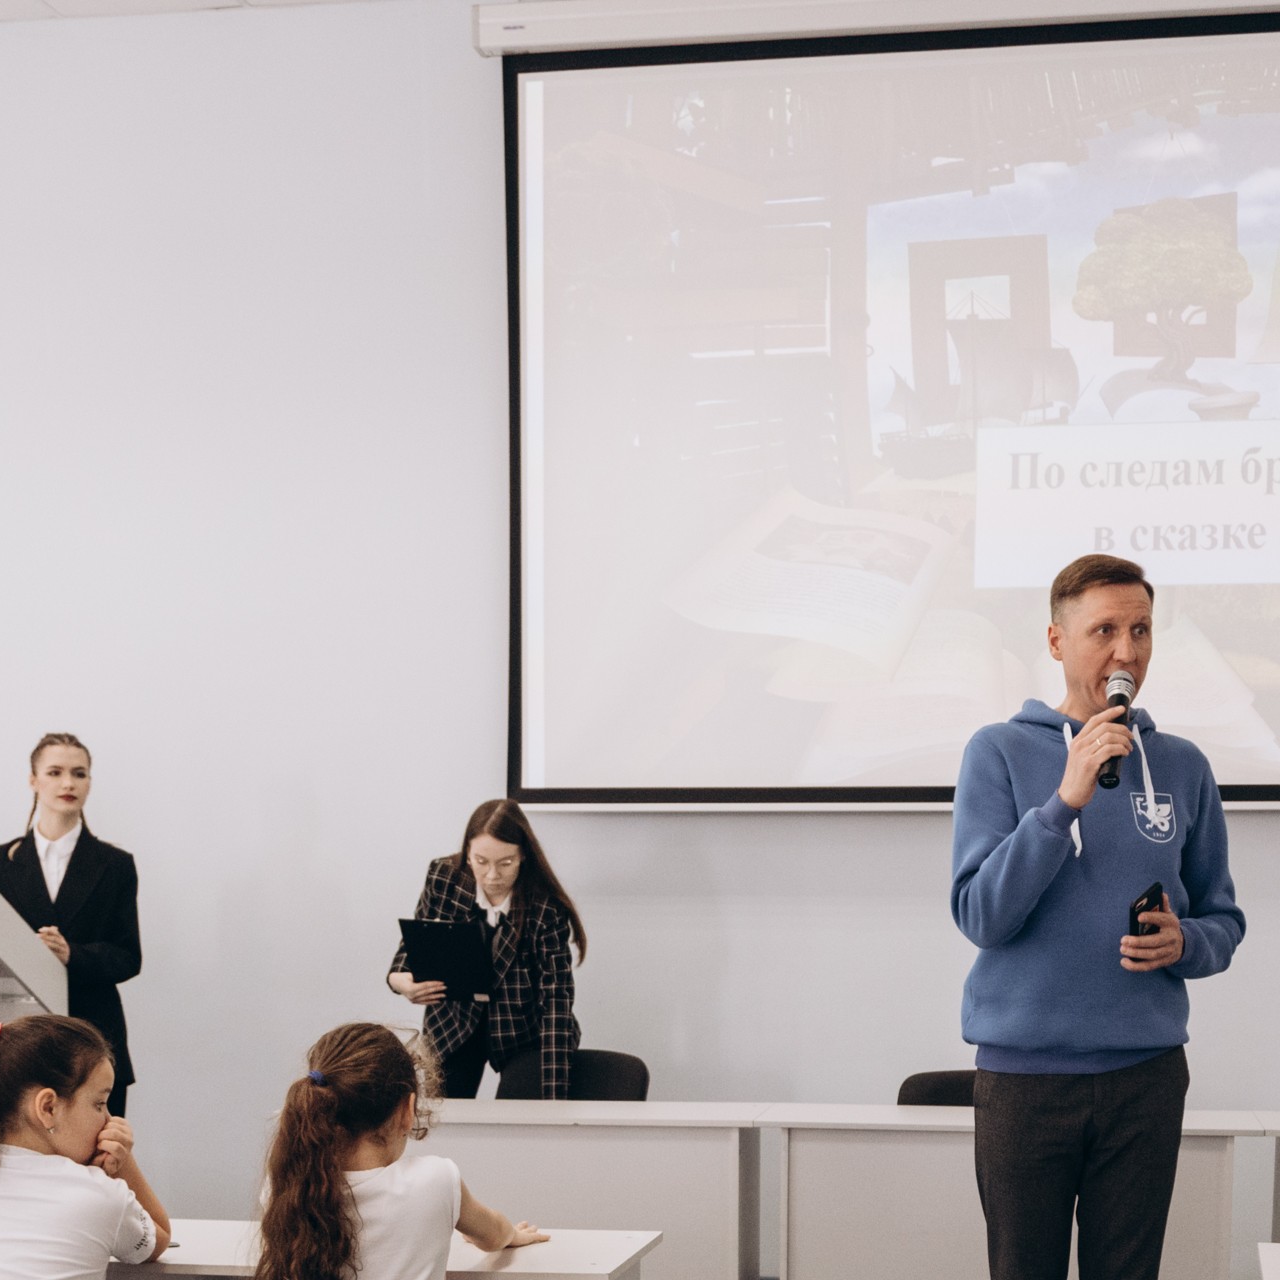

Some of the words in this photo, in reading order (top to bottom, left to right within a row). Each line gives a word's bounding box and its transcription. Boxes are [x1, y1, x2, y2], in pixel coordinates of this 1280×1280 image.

[1008, 452, 1066, 490] По
[1079, 457, 1226, 492] следам
[1093, 526, 1116, 552] в
[1130, 521, 1267, 551] сказке
